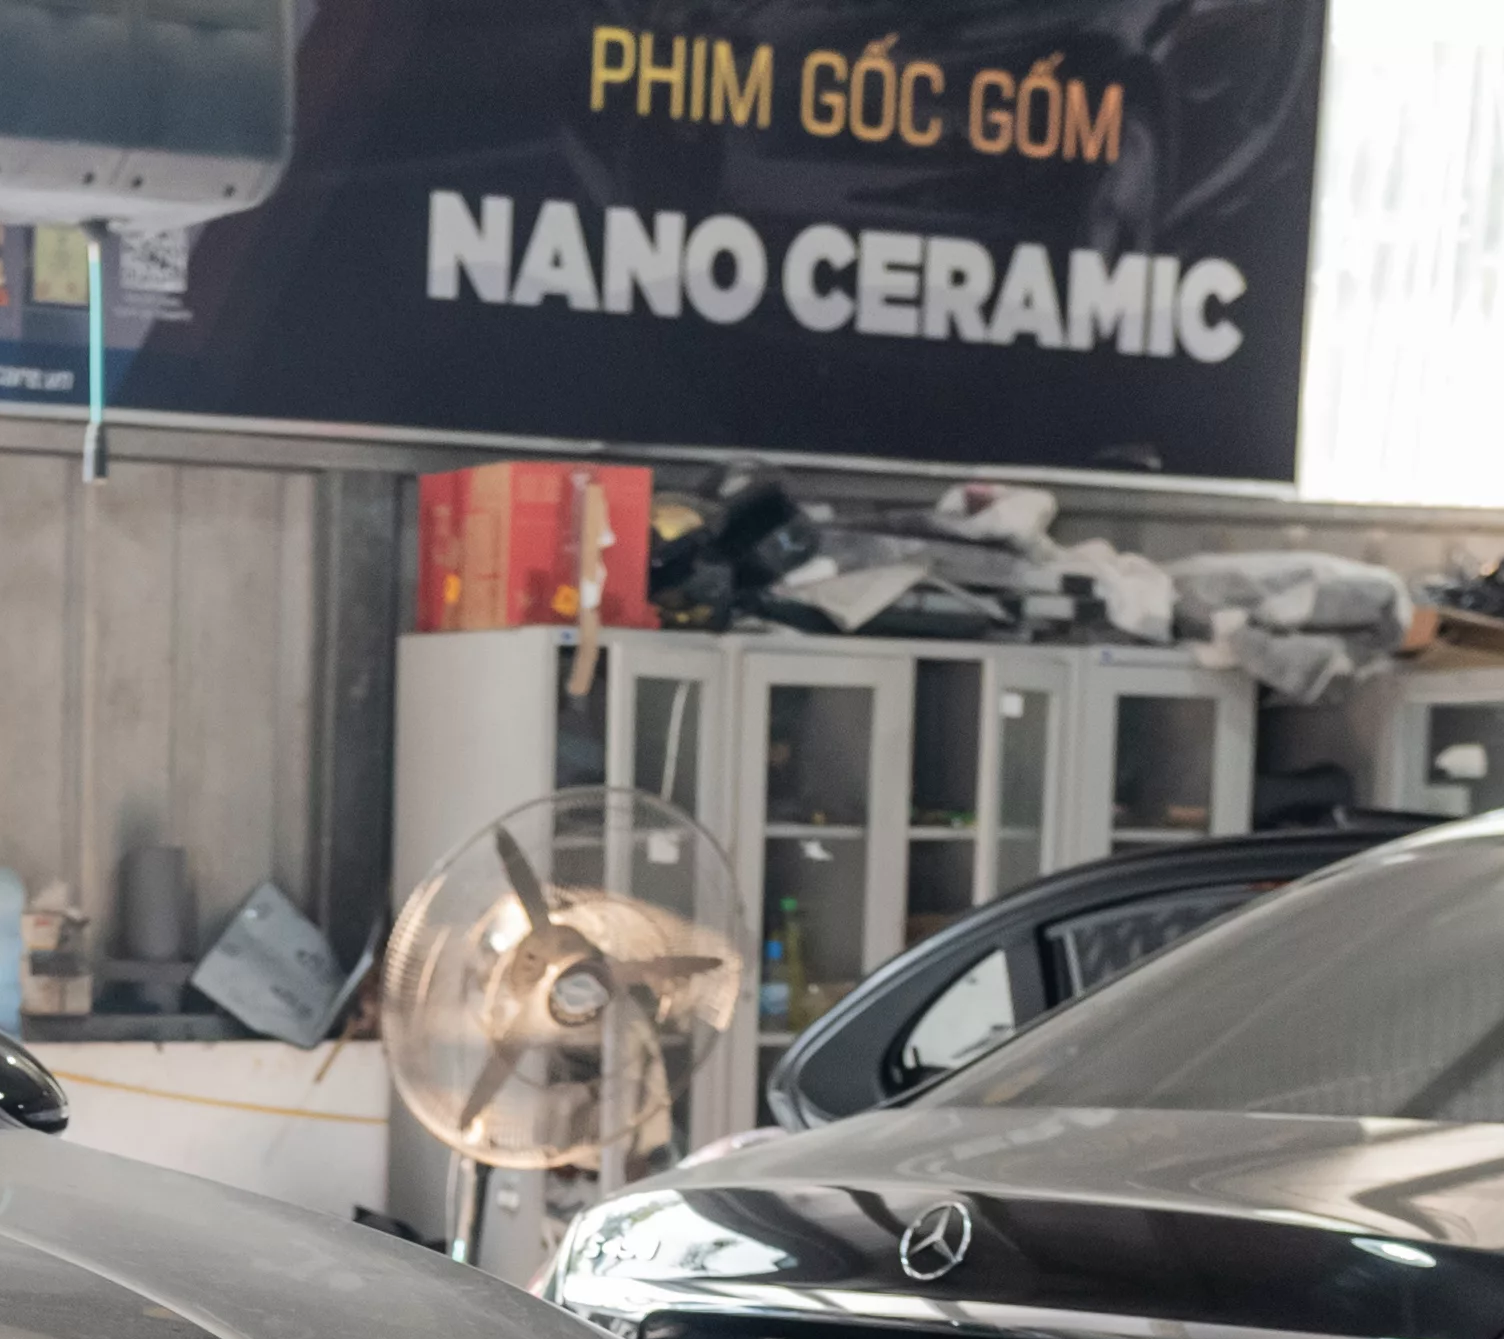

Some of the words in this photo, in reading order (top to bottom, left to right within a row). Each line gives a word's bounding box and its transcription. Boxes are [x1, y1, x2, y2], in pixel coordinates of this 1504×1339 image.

[589, 25, 775, 130] PHIM
[798, 31, 948, 149] GỐC
[967, 50, 1125, 165] GỐM
[425, 189, 770, 325] NANO
[780, 222, 1249, 364] CERAMIC
